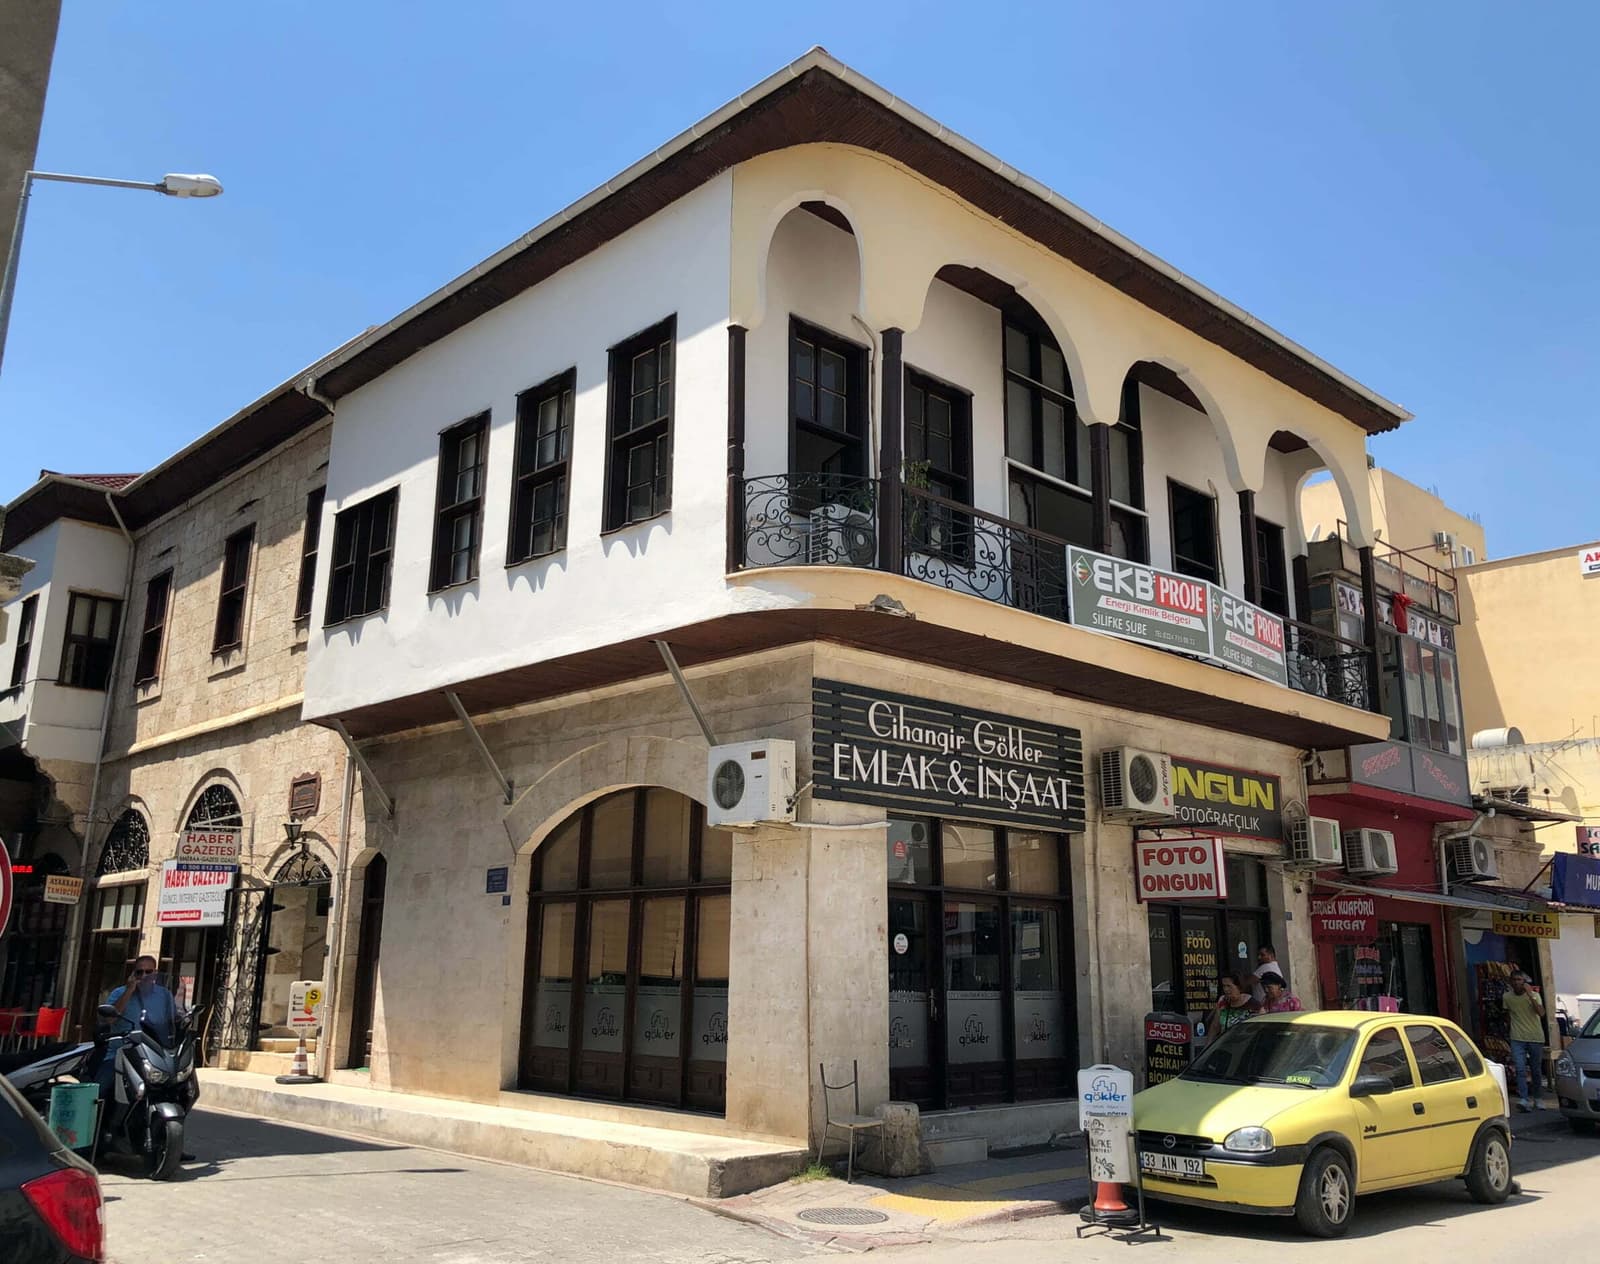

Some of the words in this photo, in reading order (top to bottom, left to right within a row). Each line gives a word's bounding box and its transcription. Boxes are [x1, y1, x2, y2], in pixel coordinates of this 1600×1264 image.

[1093, 558, 1154, 601] EKB
[1160, 576, 1204, 613] PROJE
[1105, 598, 1132, 613] Enerji
[1132, 603, 1160, 618] Kimlik
[1161, 610, 1191, 626] Belgesi
[1256, 614, 1282, 648] PROJE
[868, 701, 966, 755] Cihangir
[973, 720, 1043, 763] Gökler
[833, 743, 939, 792] EMLAK
[947, 759, 968, 795] &
[978, 758, 1072, 810] İNŞAAT
[1174, 804, 1261, 832] FOTOĞRAFÇILIK
[186, 834, 234, 844] HABER
[182, 845, 236, 856] GAZETESİ
[1143, 846, 1207, 866] FOTO
[165, 869, 190, 888] HABER
[1142, 873, 1213, 891] ONGUN
[1586, 874, 1600, 891] MU
[1322, 919, 1366, 931] TURGAY
[1498, 911, 1552, 924] TEKEL
[1187, 937, 1211, 949] FOTO
[1184, 953, 1216, 965] ONGUN
[310, 990, 318, 1000] S
[1153, 1022, 1182, 1031] FOTO
[1149, 1030, 1186, 1040] ONGUN
[1155, 1043, 1184, 1056] ACELE
[1084, 1092, 1127, 1103] gökler
[1144, 1151, 1156, 1167] 33
[1161, 1155, 1177, 1171] AIN
[1183, 1159, 1200, 1173] 192
